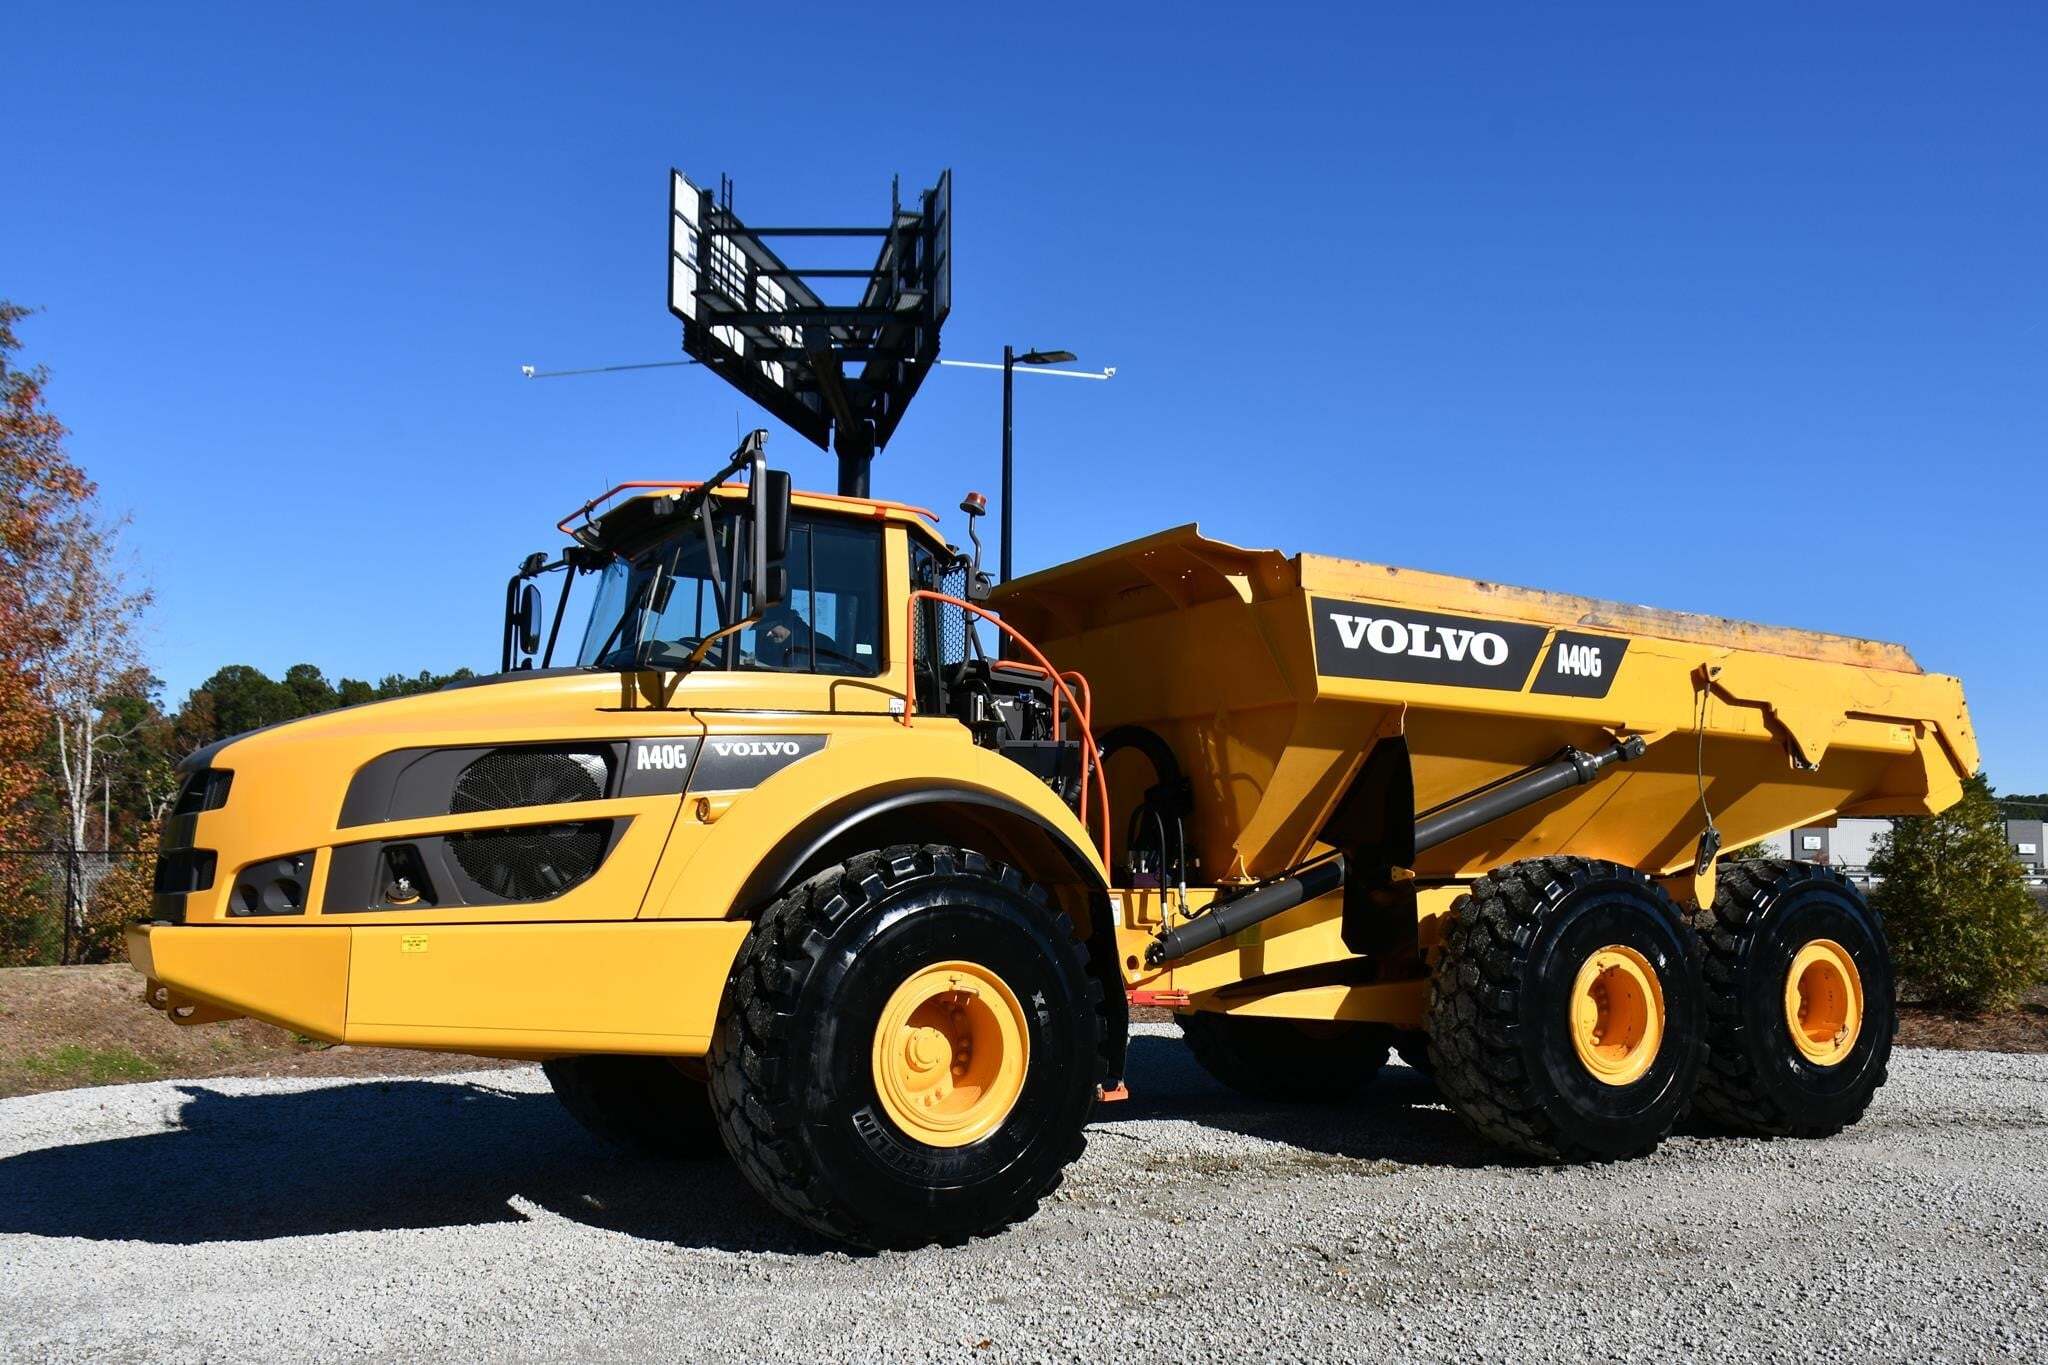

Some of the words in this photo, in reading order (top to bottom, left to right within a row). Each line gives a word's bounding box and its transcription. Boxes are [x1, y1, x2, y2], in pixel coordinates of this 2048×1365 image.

[1330, 613, 1509, 666] VOLVO
[1557, 643, 1602, 678] A40G
[637, 744, 687, 770] A40G
[712, 741, 800, 756] VOLVO
